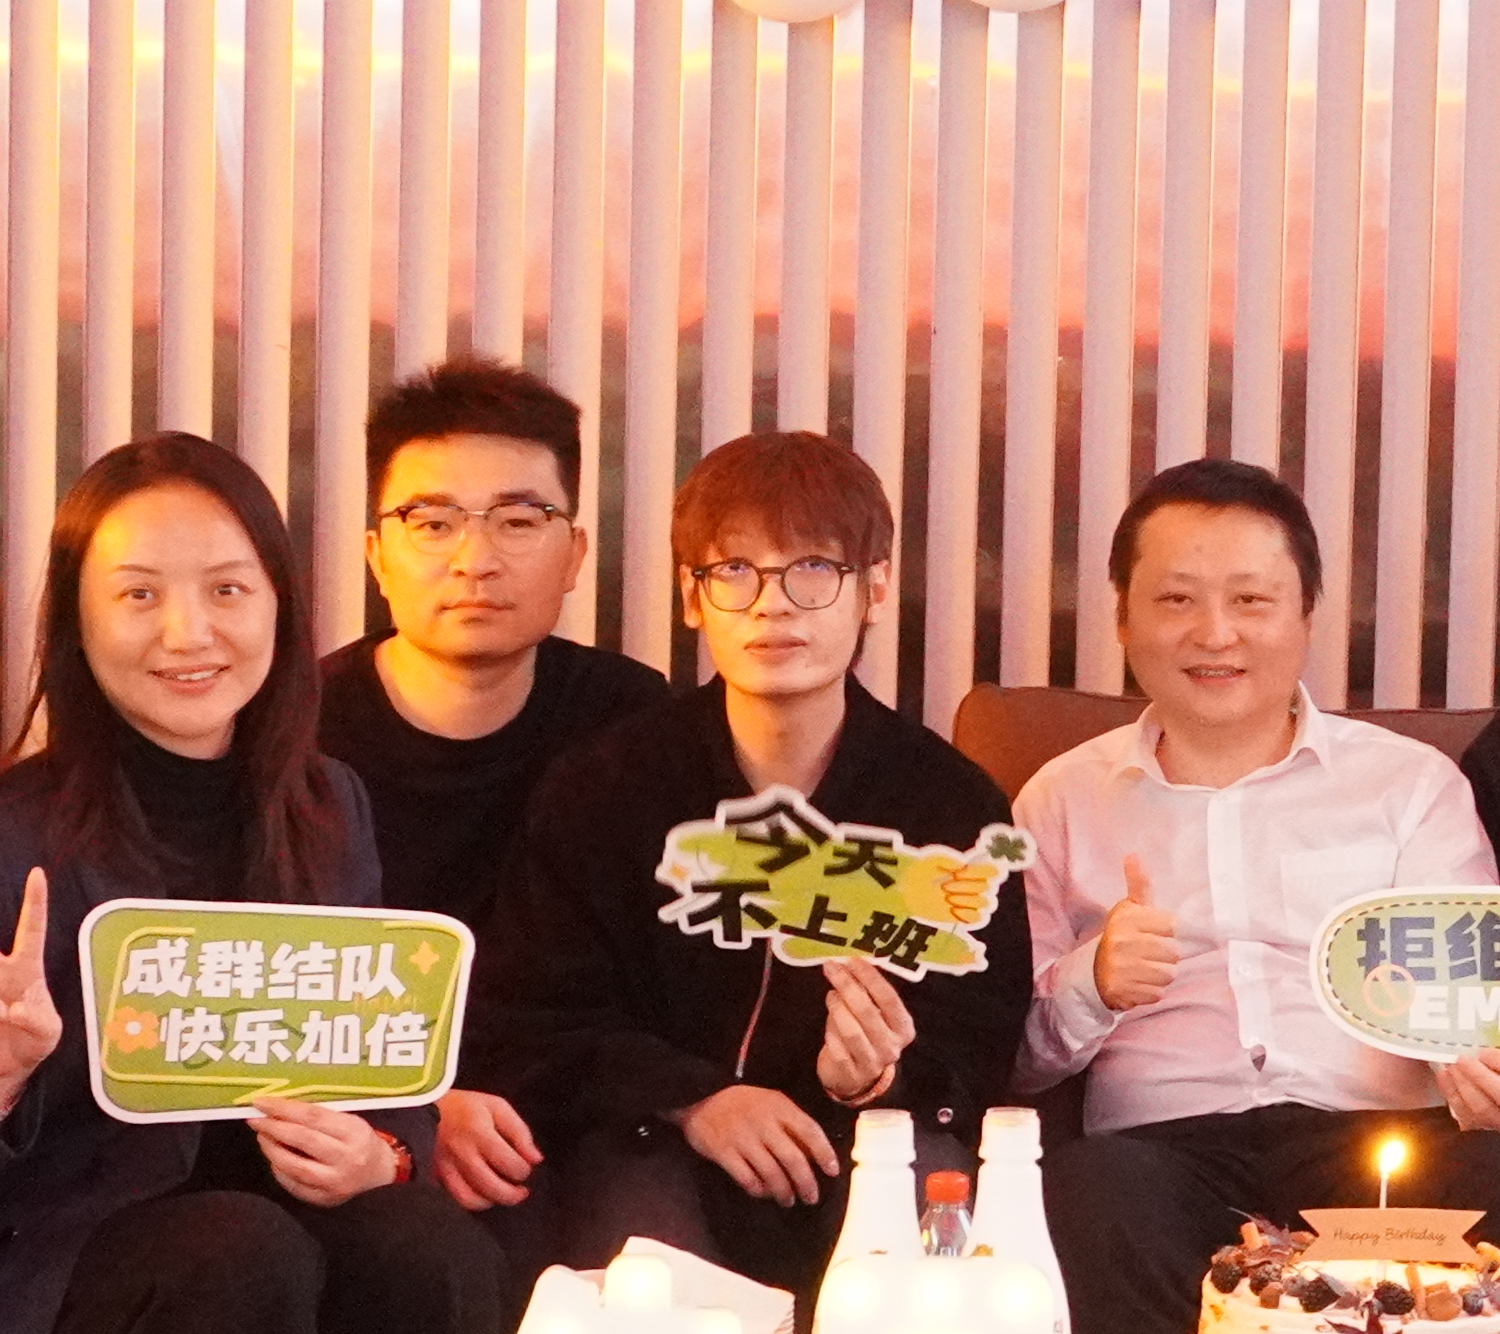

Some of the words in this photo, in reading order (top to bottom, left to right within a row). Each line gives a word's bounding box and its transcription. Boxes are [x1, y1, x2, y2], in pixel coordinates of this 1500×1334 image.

[724, 801, 902, 889] 今天
[687, 879, 940, 972] 不上班
[121, 937, 407, 1002] 成群结队
[159, 1008, 430, 1067] 快乐加倍
[1333, 1227, 1380, 1246] Happy
[1385, 1227, 1448, 1246] Birthday
